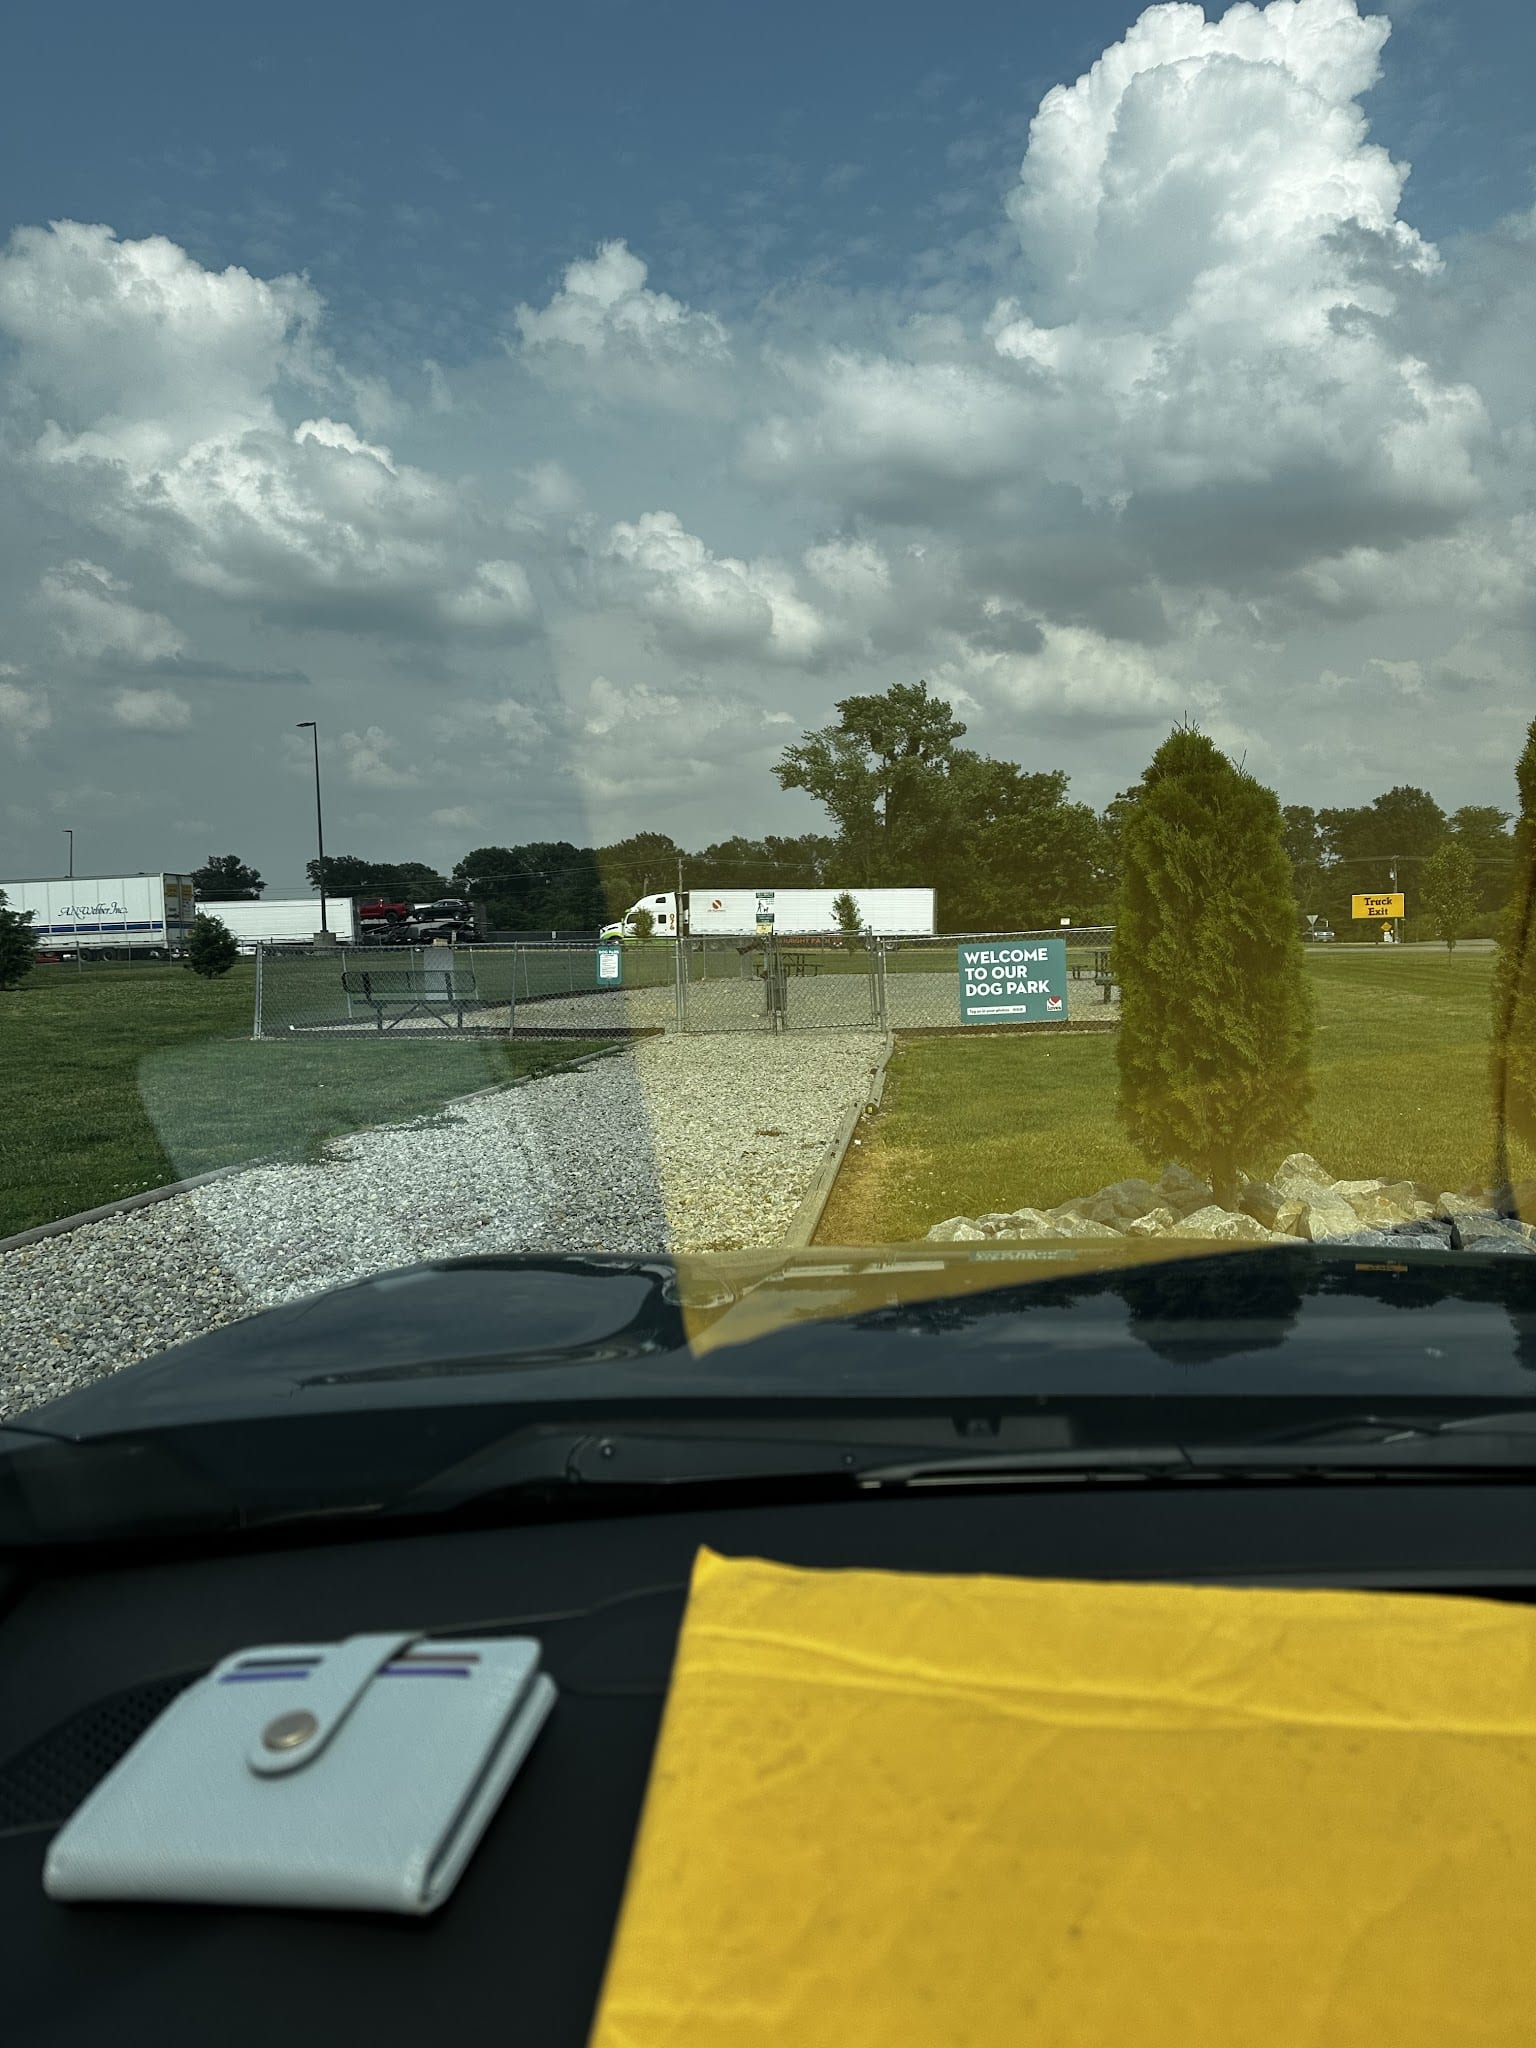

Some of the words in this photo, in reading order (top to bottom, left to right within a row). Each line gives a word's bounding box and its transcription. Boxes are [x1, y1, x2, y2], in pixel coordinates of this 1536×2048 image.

[1364, 896, 1392, 906] Truck
[1367, 907, 1388, 916] Exit
[964, 948, 1048, 964] WELCOME
[965, 967, 988, 981] TO
[991, 965, 1027, 979] OUR
[965, 982, 1003, 996] DOG
[1006, 979, 1050, 994] PARK
